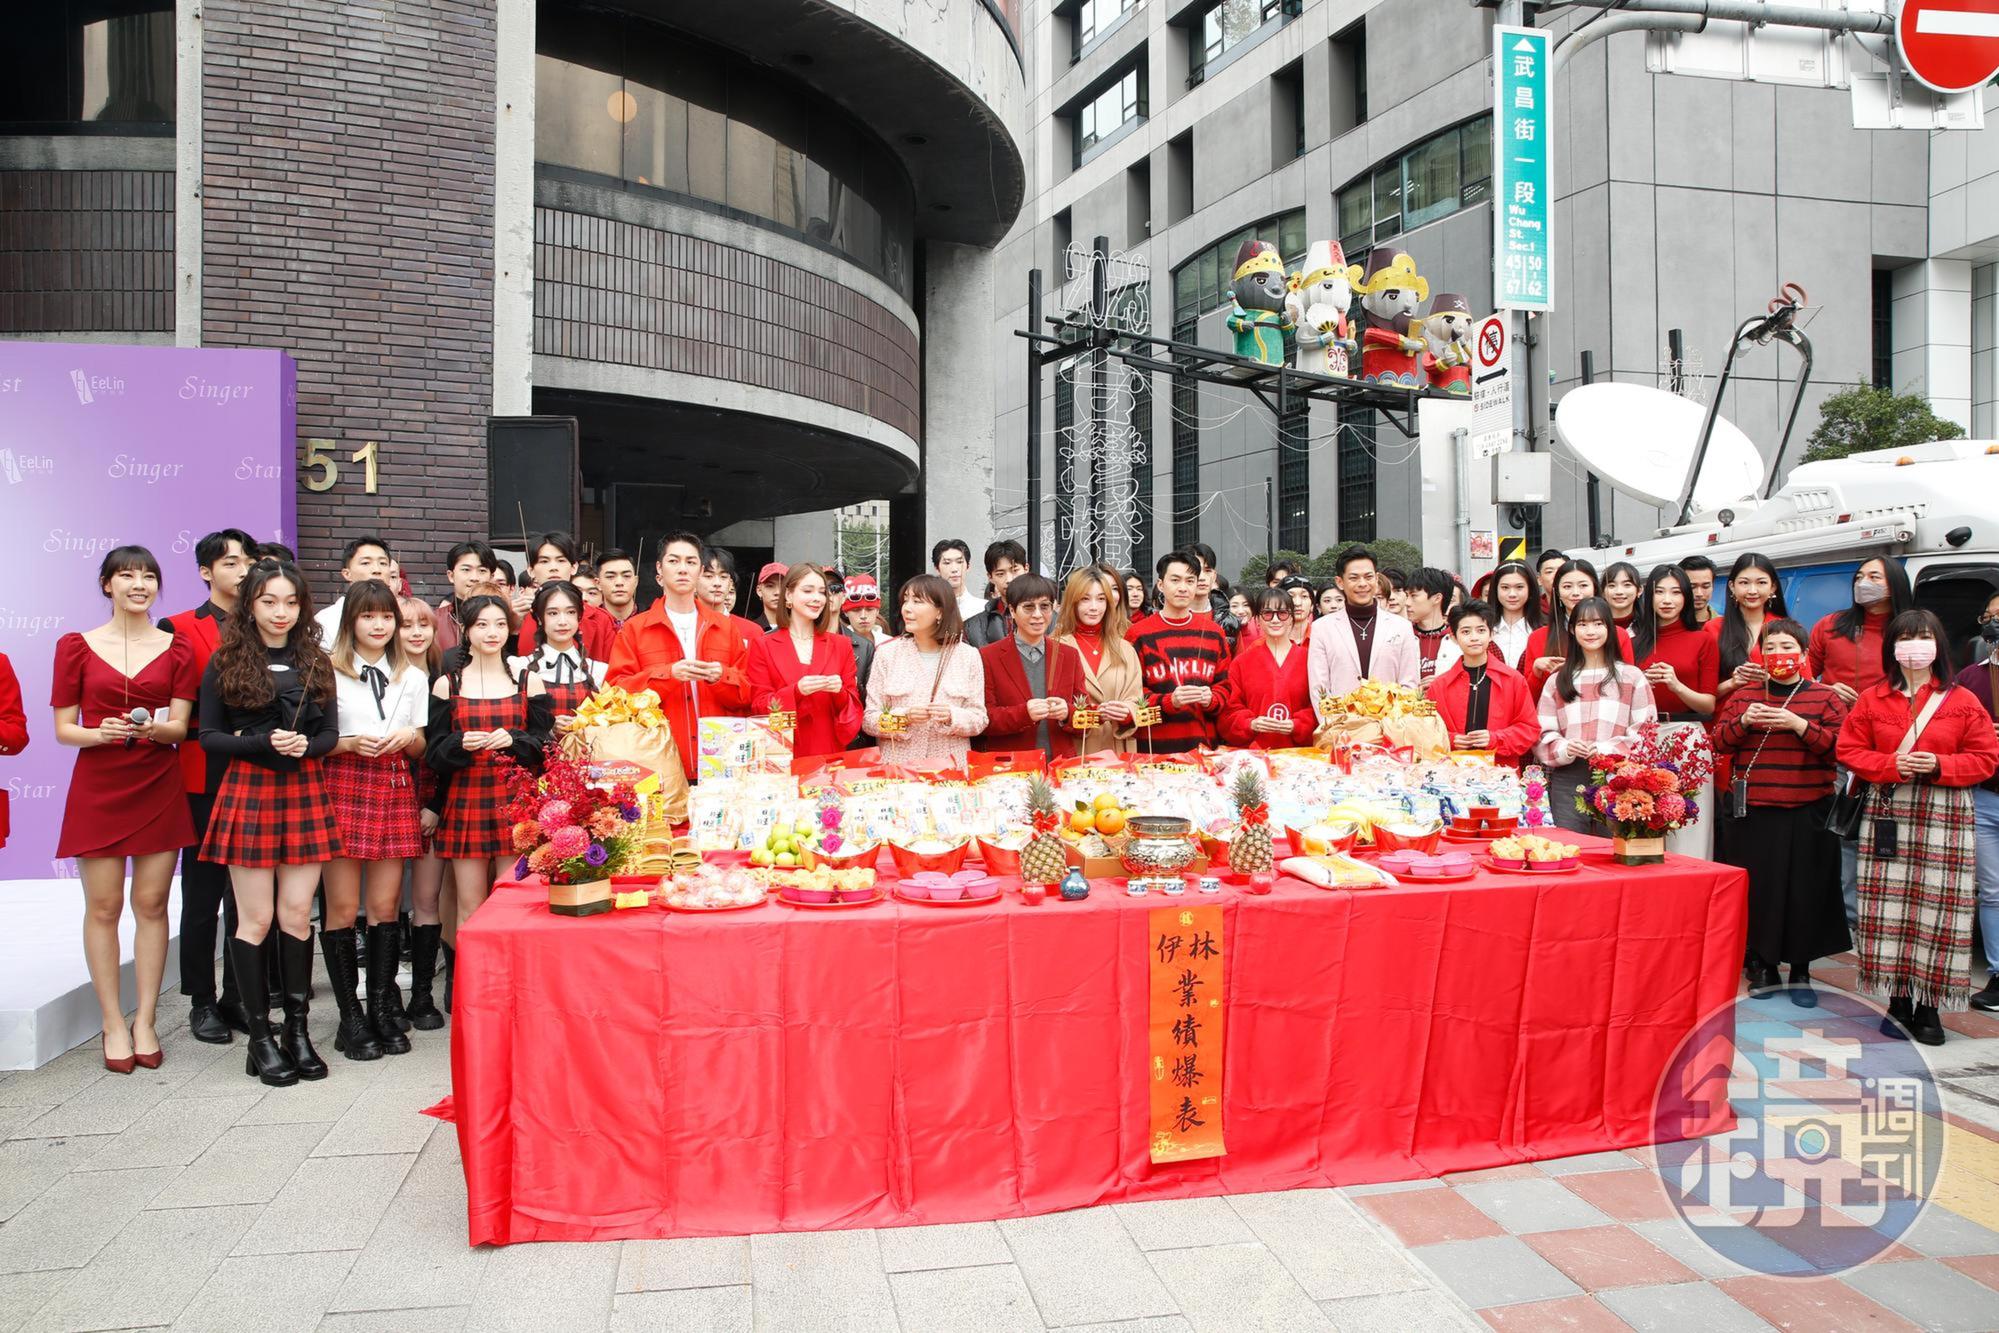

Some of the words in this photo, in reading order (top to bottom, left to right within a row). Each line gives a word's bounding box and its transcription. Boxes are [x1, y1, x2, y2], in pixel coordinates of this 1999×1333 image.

[1513, 54, 1536, 204] 武昌街一段
[1508, 204, 1526, 216] Wu
[1508, 217, 1541, 231] Chang
[1505, 255, 1521, 270] 45
[1528, 256, 1542, 271] 50
[1506, 280, 1521, 295] 67
[1527, 281, 1542, 297] 62
[91, 376, 125, 390] EeLin
[178, 375, 254, 406] Singer
[19, 455, 53, 469] EeLin
[107, 454, 184, 484] Singer
[301, 438, 379, 494] 51
[43, 528, 120, 559] Singer
[9, 776, 57, 801] Star
[1157, 930, 1220, 964] 伊林
[1171, 968, 1205, 1133] 業績爆表
